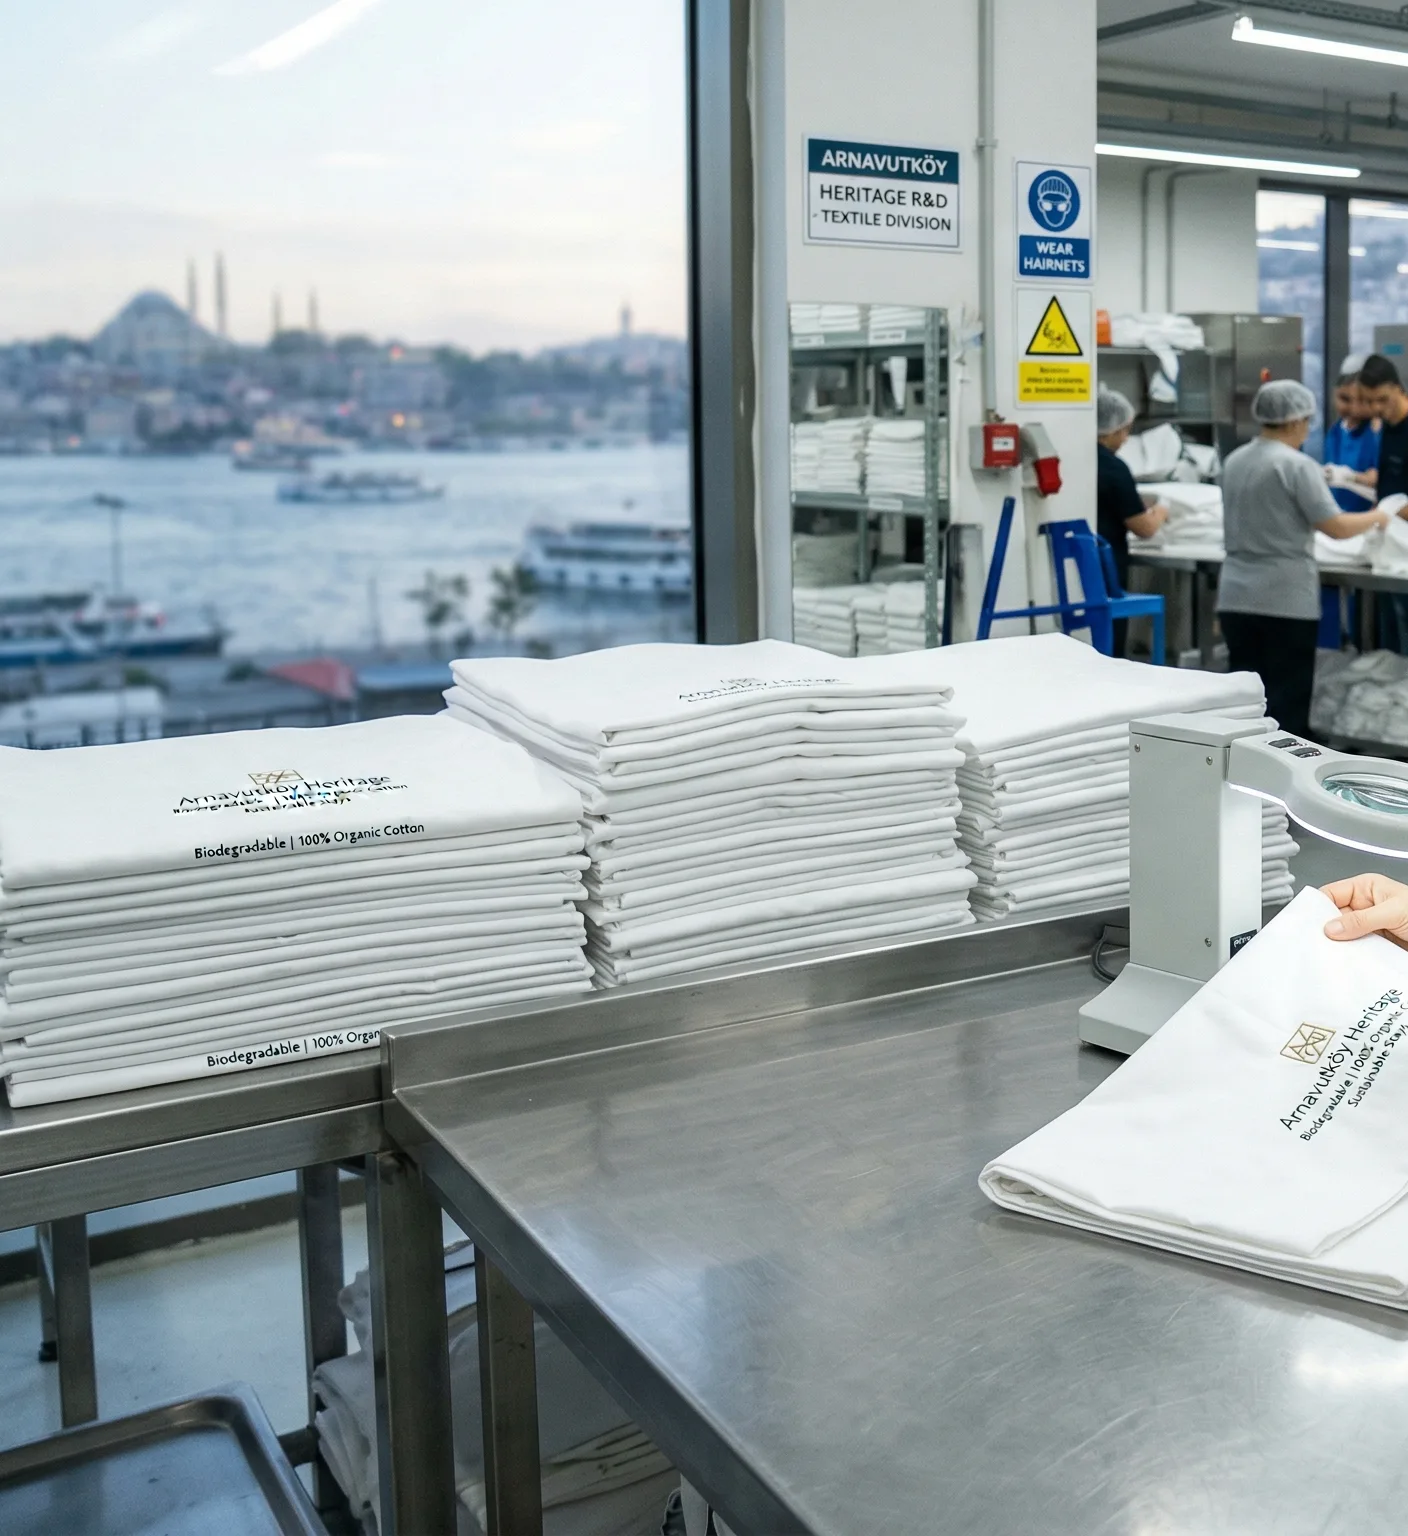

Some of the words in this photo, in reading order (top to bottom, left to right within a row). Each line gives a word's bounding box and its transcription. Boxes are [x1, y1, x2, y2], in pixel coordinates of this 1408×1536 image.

[821, 149, 948, 176] ARNAVUTKÖY
[819, 184, 907, 206] HERITAGE
[911, 191, 948, 209] R&D
[820, 209, 882, 226] TEXTILE
[885, 214, 952, 231] DIVISION
[1035, 241, 1074, 256] WEAR
[1023, 256, 1086, 273] HAIRNETS
[298, 831, 331, 847] 100%
[383, 822, 425, 837] Cotton
[207, 1040, 300, 1067] Biodegradable
[311, 1032, 344, 1049] 100%
